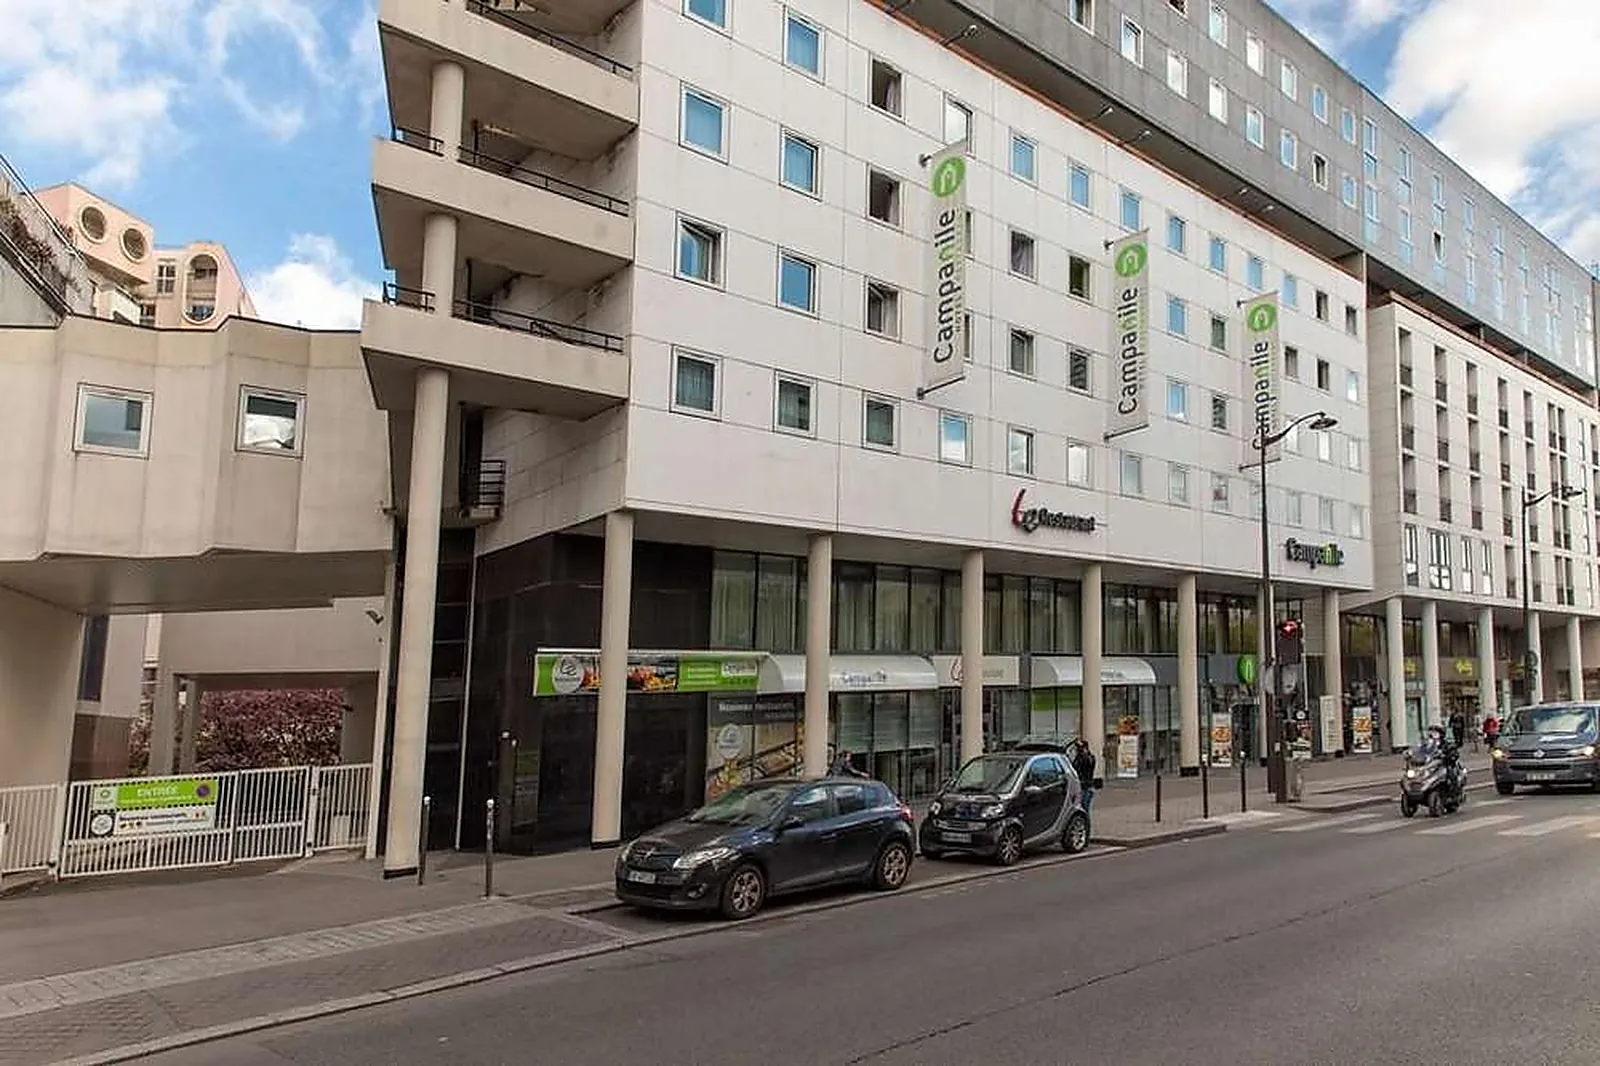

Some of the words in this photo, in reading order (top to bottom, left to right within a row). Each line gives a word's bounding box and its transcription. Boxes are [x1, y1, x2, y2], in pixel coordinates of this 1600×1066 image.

[933, 208, 962, 364] Campanile
[1117, 286, 1146, 415] Campanile
[1249, 341, 1277, 450] Campanile
[1286, 537, 1345, 570] Campanile
